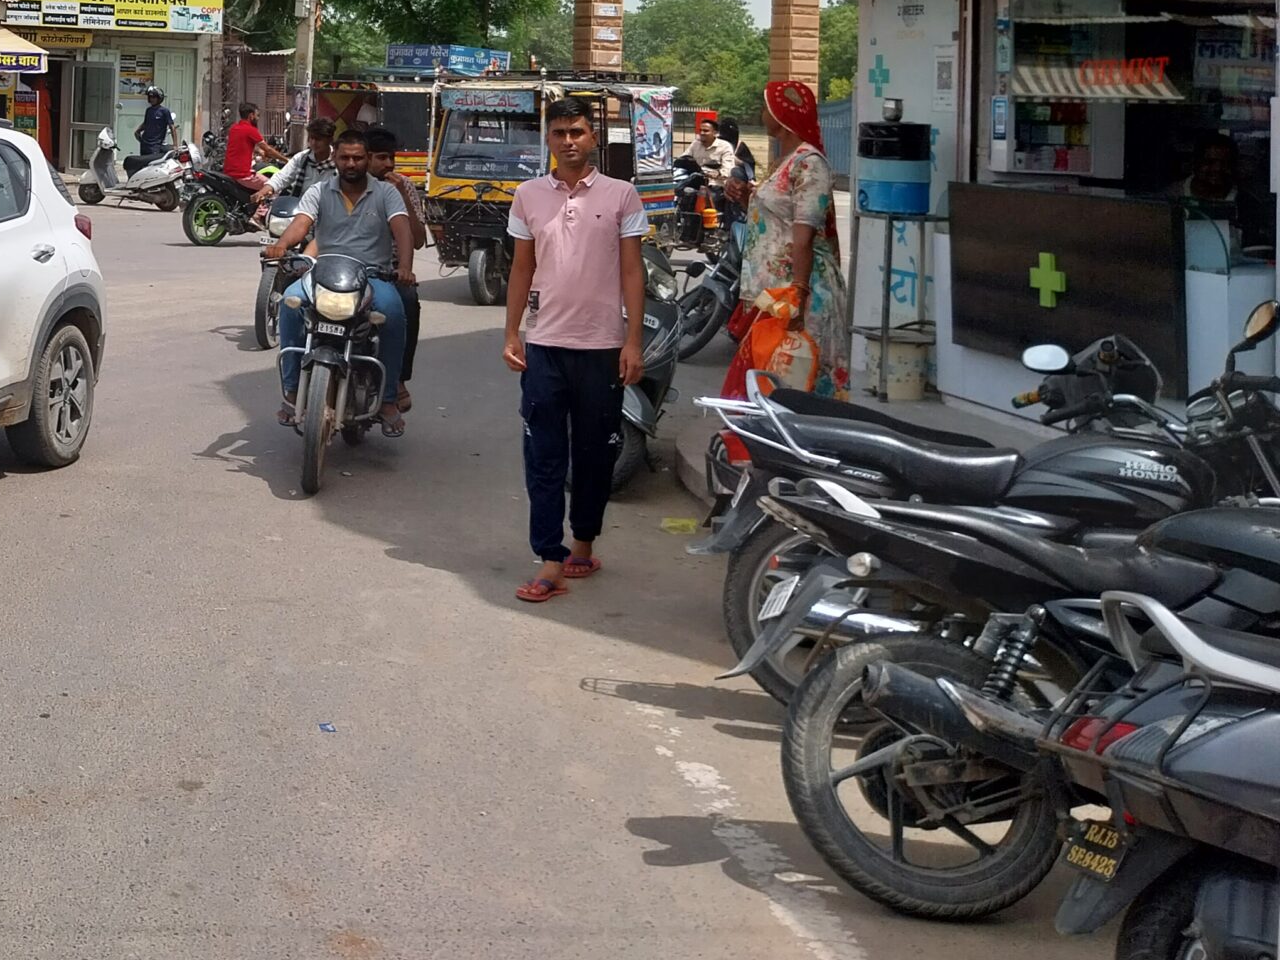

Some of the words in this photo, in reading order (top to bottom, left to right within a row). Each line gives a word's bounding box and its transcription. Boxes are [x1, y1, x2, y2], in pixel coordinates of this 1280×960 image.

[201, 6, 222, 14] COPY
[415, 46, 429, 57] पान
[18, 55, 40, 67] चाय
[1078, 56, 1169, 87] CHEMIST
[1125, 460, 1178, 474] HERO
[1119, 467, 1184, 483] HONDA
